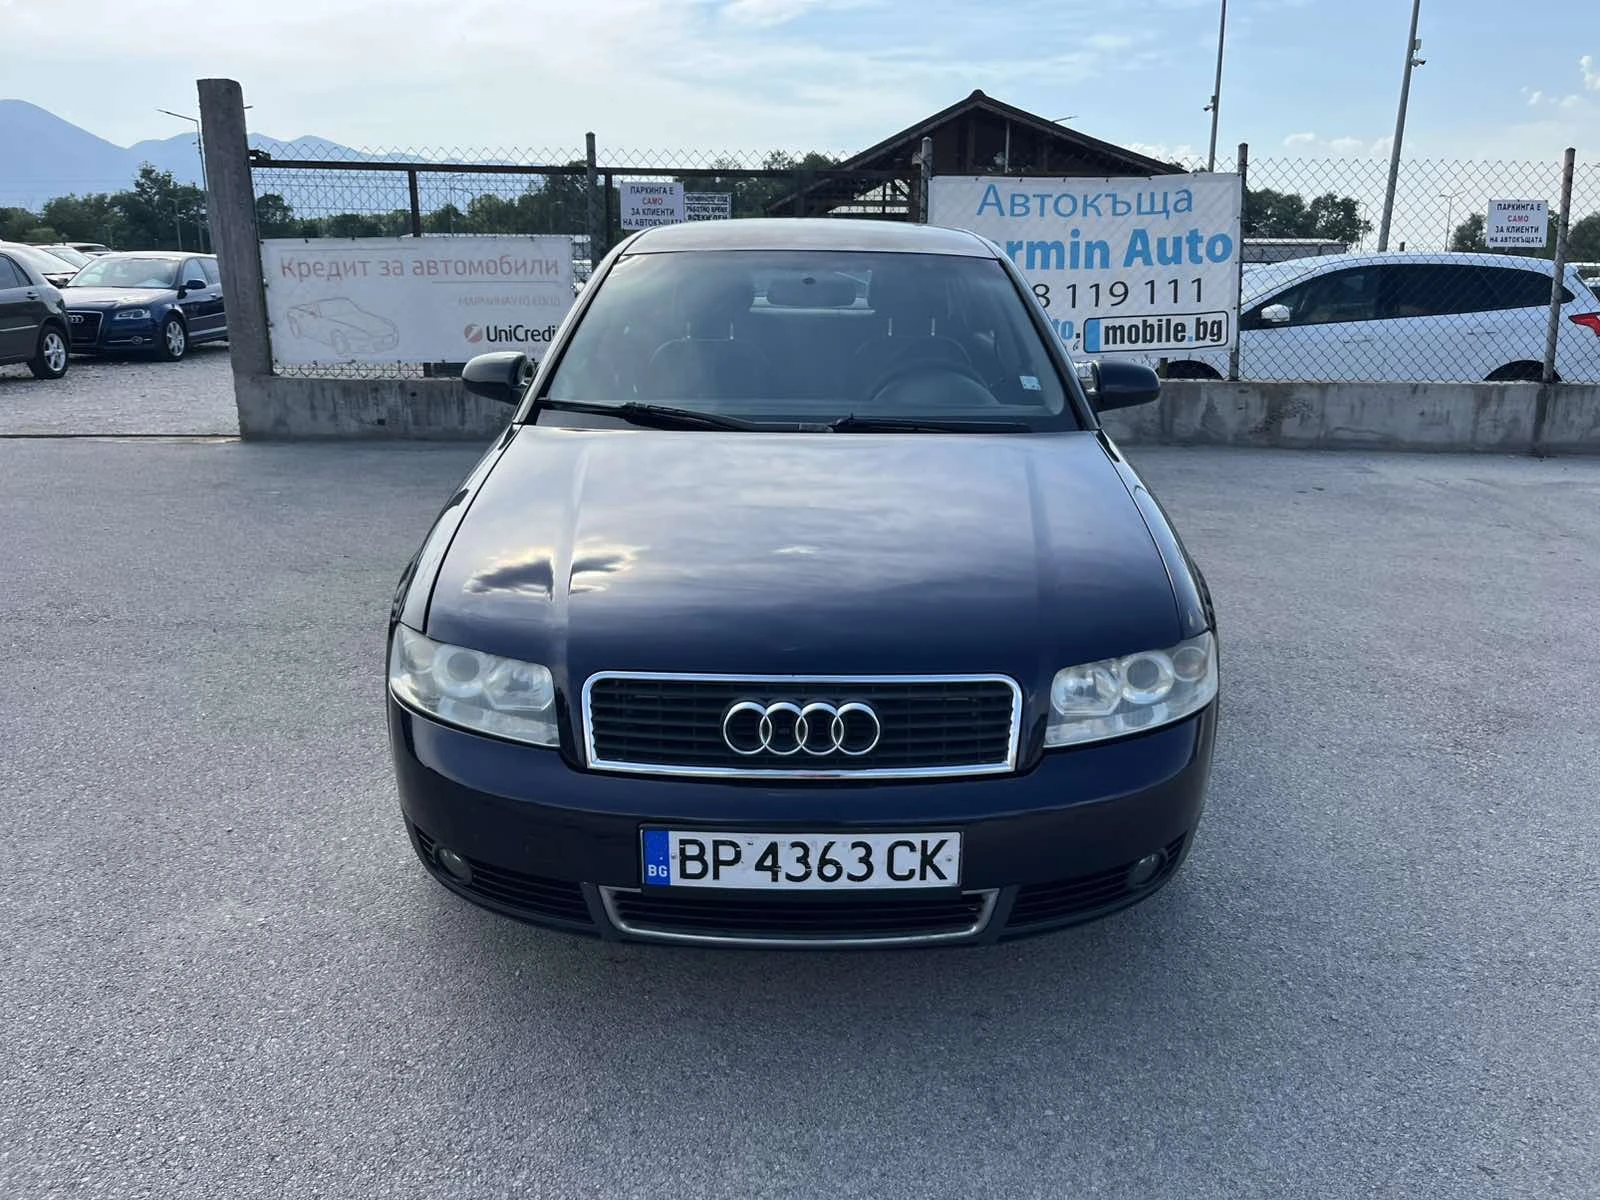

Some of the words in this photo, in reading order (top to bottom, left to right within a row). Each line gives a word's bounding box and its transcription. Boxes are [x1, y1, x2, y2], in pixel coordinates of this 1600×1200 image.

[630, 186, 667, 195] ПАРКИНГА
[642, 197, 663, 206] САМО
[976, 183, 1193, 219] Автокъща
[631, 208, 640, 216] ЗА
[642, 208, 675, 216] КЛИЕНТИ
[1497, 203, 1534, 211] ПАРКИНГА
[992, 228, 1111, 270] rmin
[1123, 228, 1233, 268] Auto
[279, 256, 371, 282] Кредит
[379, 260, 404, 277] за
[412, 255, 559, 276] автомобили
[1066, 281, 1129, 308] 119
[1144, 277, 1202, 305] 111
[486, 324, 560, 342] UniCredi
[1103, 317, 1222, 345] mobile.bg
[648, 864, 668, 878] BG
[679, 838, 742, 880] BP
[754, 840, 874, 883] 4363
[887, 839, 949, 882] CK
